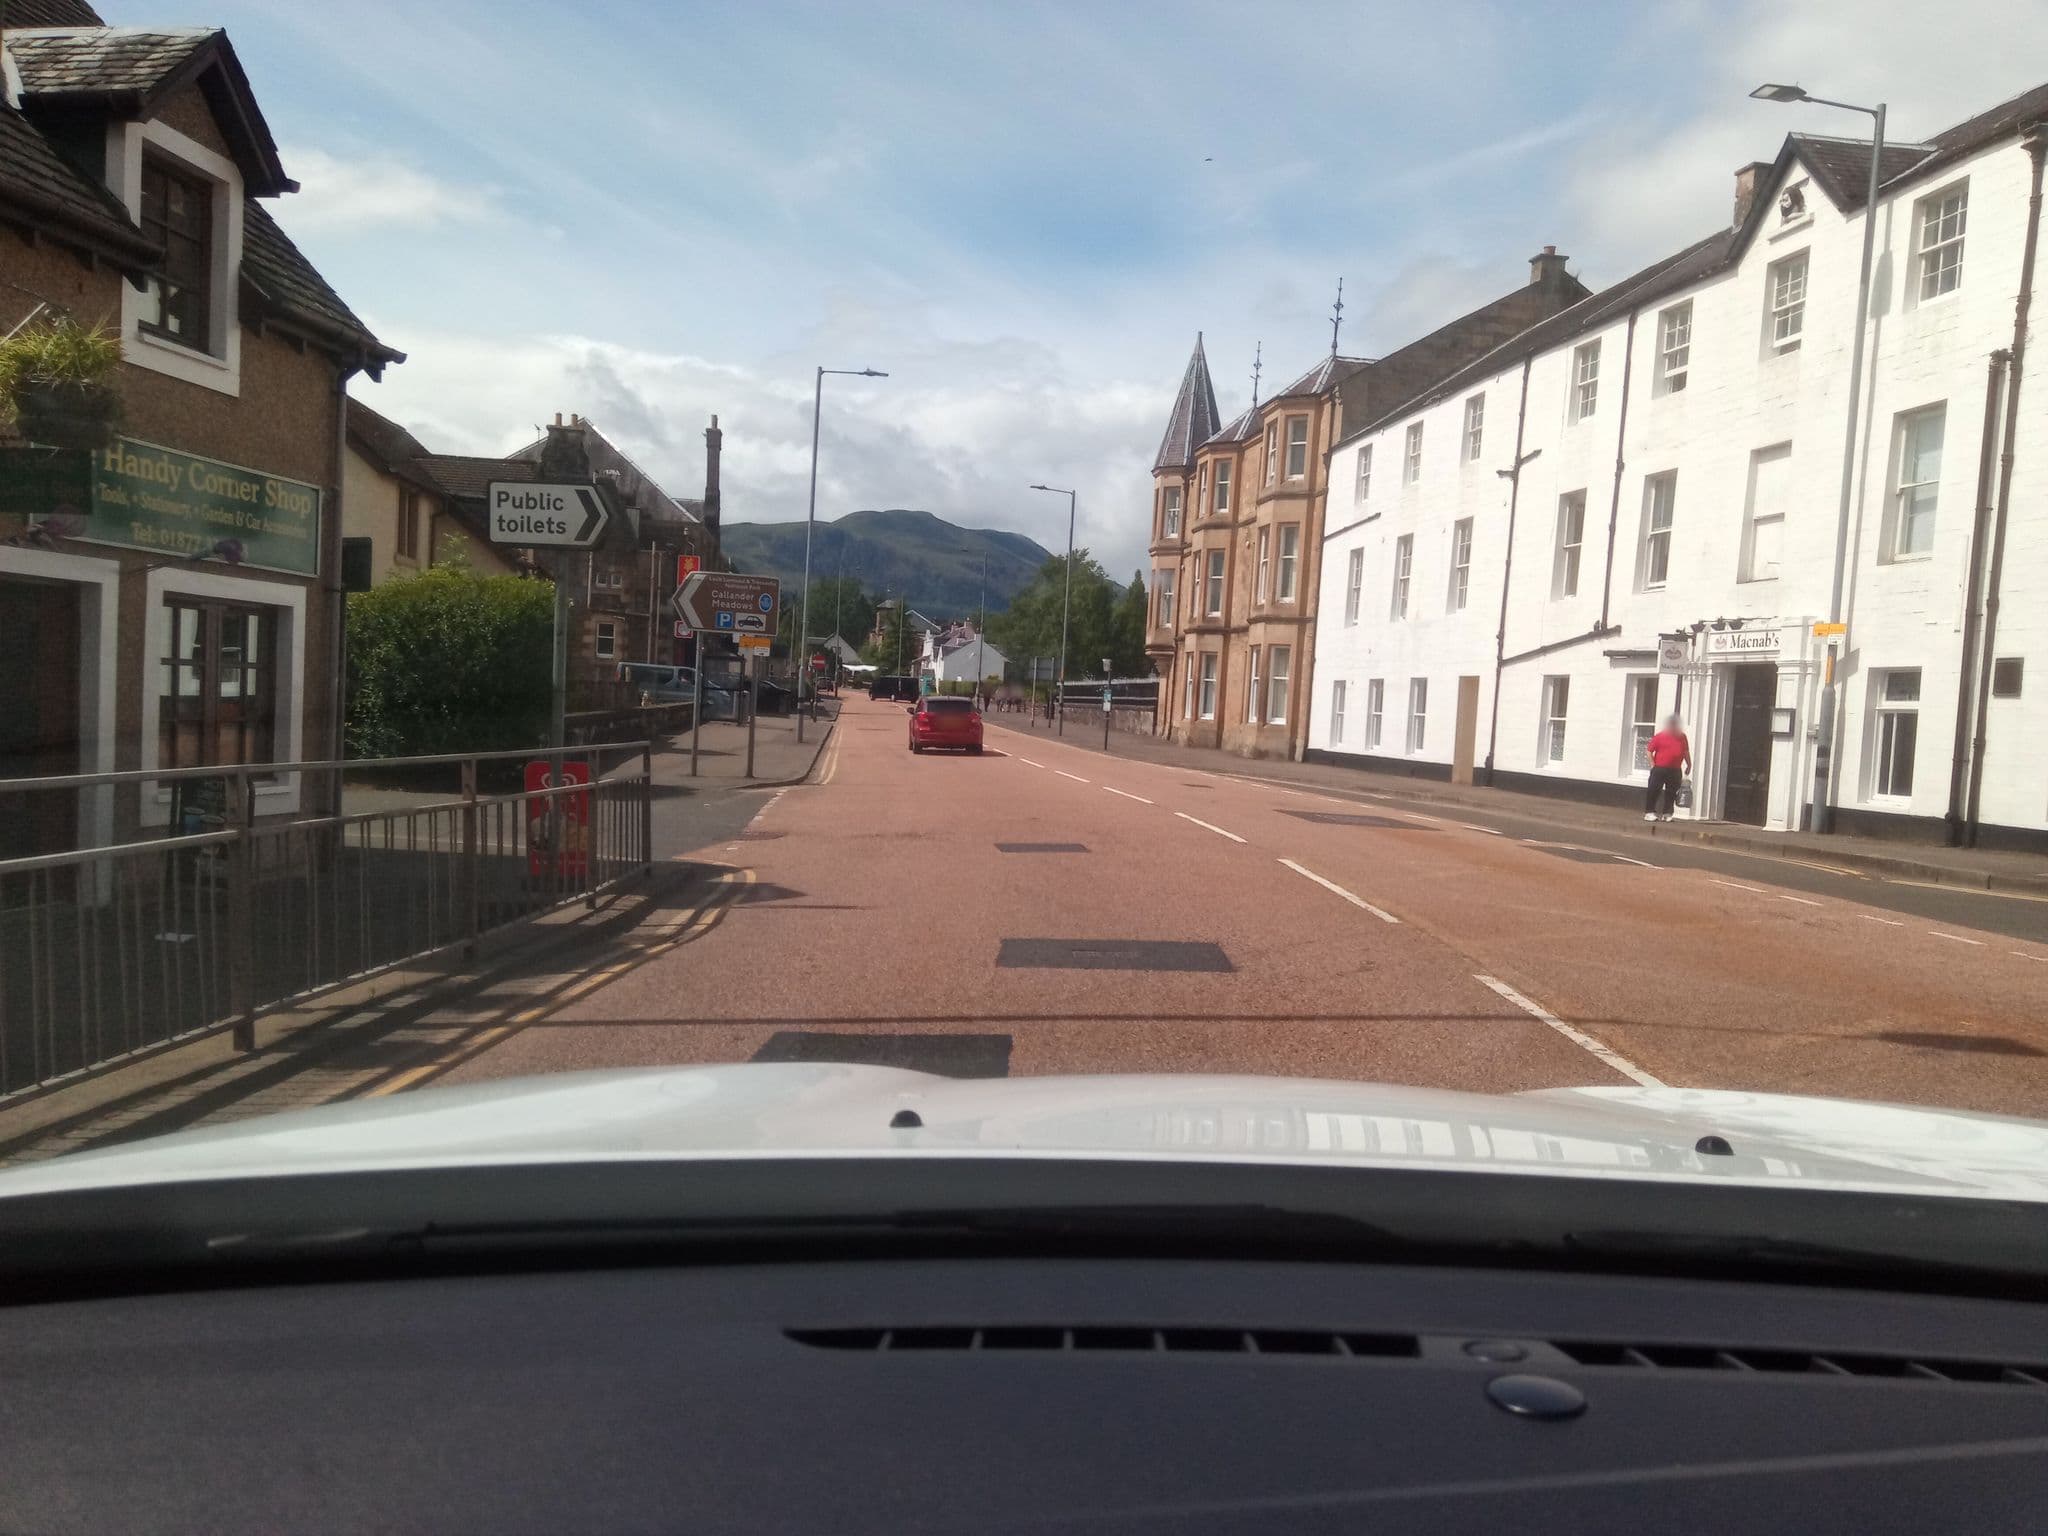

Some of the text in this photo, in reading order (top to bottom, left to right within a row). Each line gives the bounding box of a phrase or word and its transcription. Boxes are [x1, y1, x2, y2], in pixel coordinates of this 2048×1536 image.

[104, 444, 312, 519] Handy Corner Shop
[496, 490, 565, 511] Public
[497, 515, 567, 534] toilets
[711, 590, 754, 601] Callander
[711, 599, 754, 610] Meadows
[720, 613, 731, 627] P
[1729, 632, 1780, 649] Macnab's
